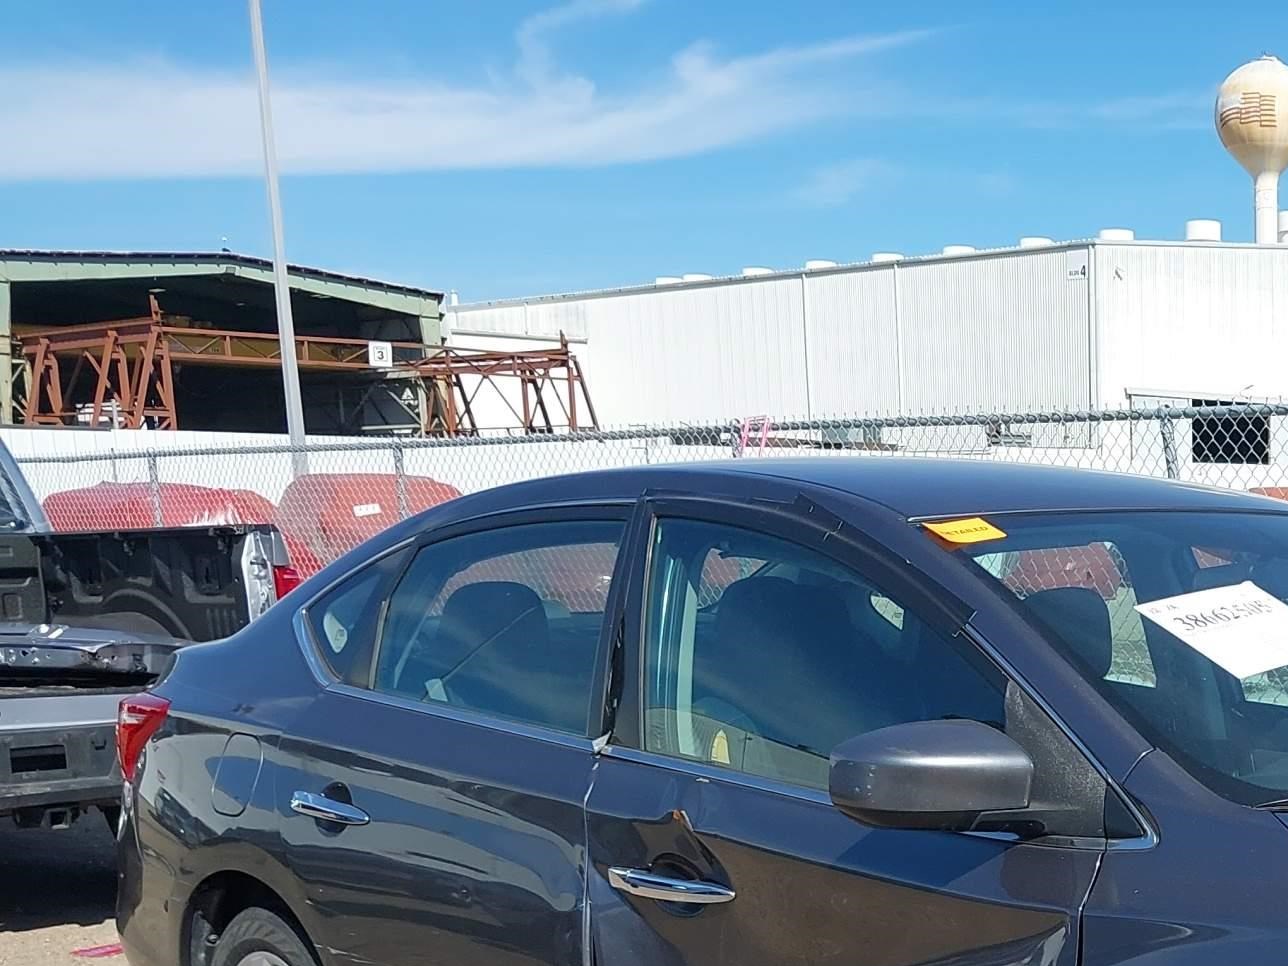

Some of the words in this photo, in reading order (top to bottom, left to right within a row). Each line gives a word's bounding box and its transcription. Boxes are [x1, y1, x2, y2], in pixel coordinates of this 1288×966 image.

[1080, 264, 1086, 278] 4
[376, 350, 385, 360] 3
[1173, 600, 1274, 632] 38662505
